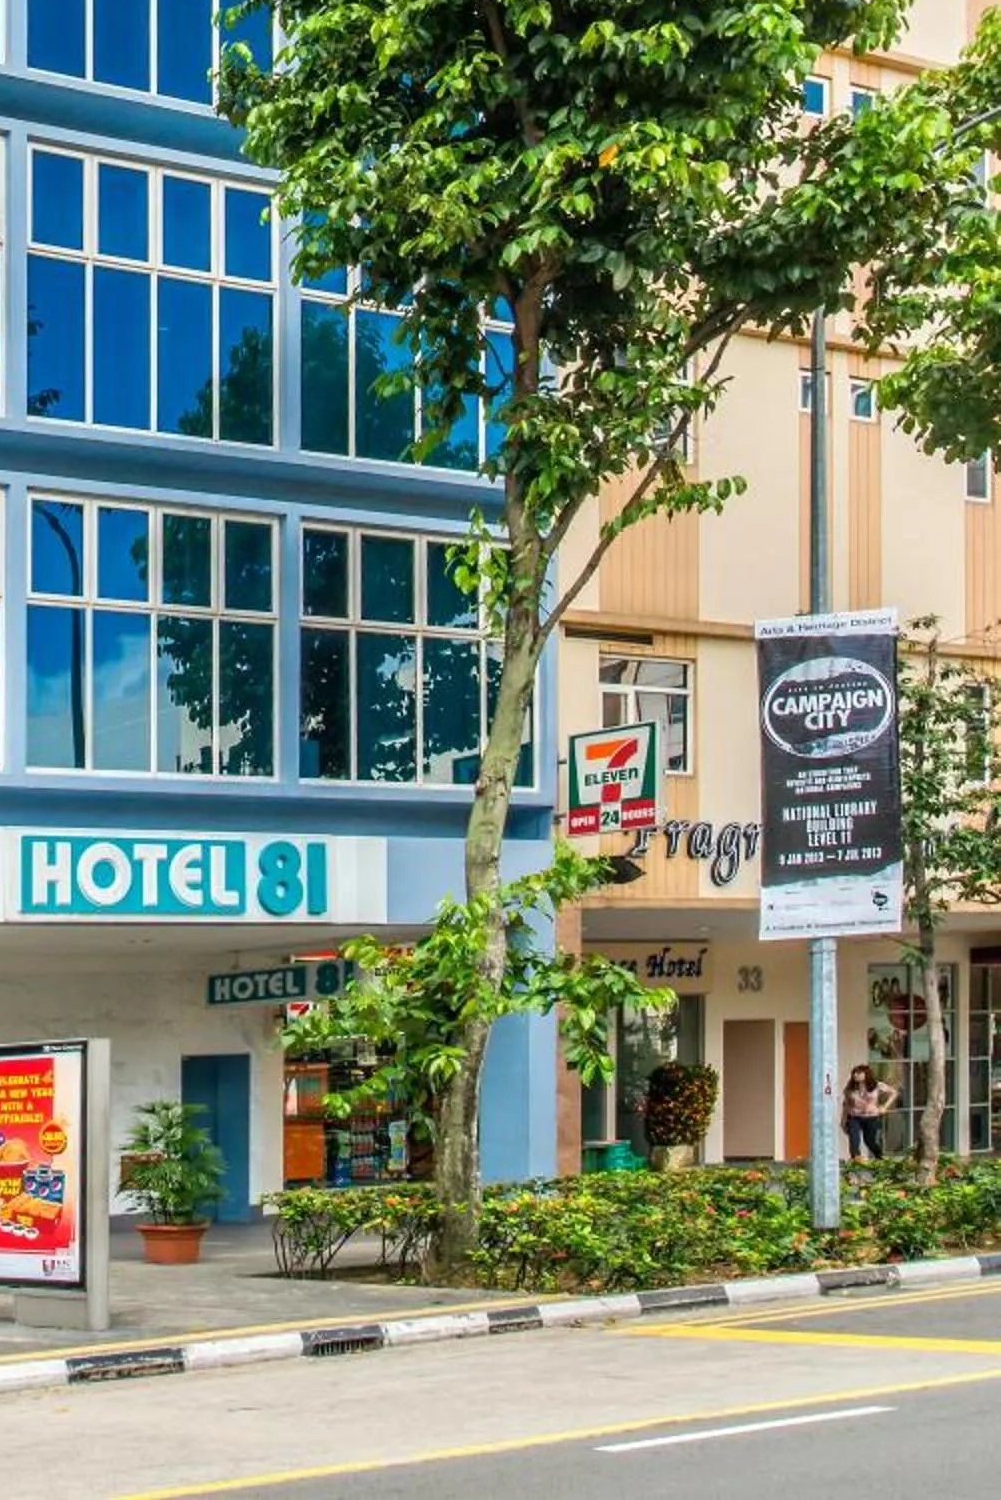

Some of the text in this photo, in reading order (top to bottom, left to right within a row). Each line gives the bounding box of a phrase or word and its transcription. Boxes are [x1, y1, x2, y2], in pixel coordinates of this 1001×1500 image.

[760, 627, 784, 636] Arts
[798, 620, 849, 632] Heritage
[850, 616, 892, 627] District
[772, 689, 884, 715] CAMPAIGN
[804, 709, 852, 730] CITY
[585, 738, 639, 803] 7
[571, 806, 655, 828] OPEN 24 HOURS
[782, 800, 878, 821] NATIONAL LIBRARY
[806, 817, 854, 833] BUILDING
[808, 831, 838, 847] LEVEL
[629, 819, 763, 887] Fragr
[30, 837, 328, 917] HOTEL 81
[646, 946, 709, 978] Hotel
[213, 970, 300, 1002] HOTEL
[737, 965, 764, 992] 33
